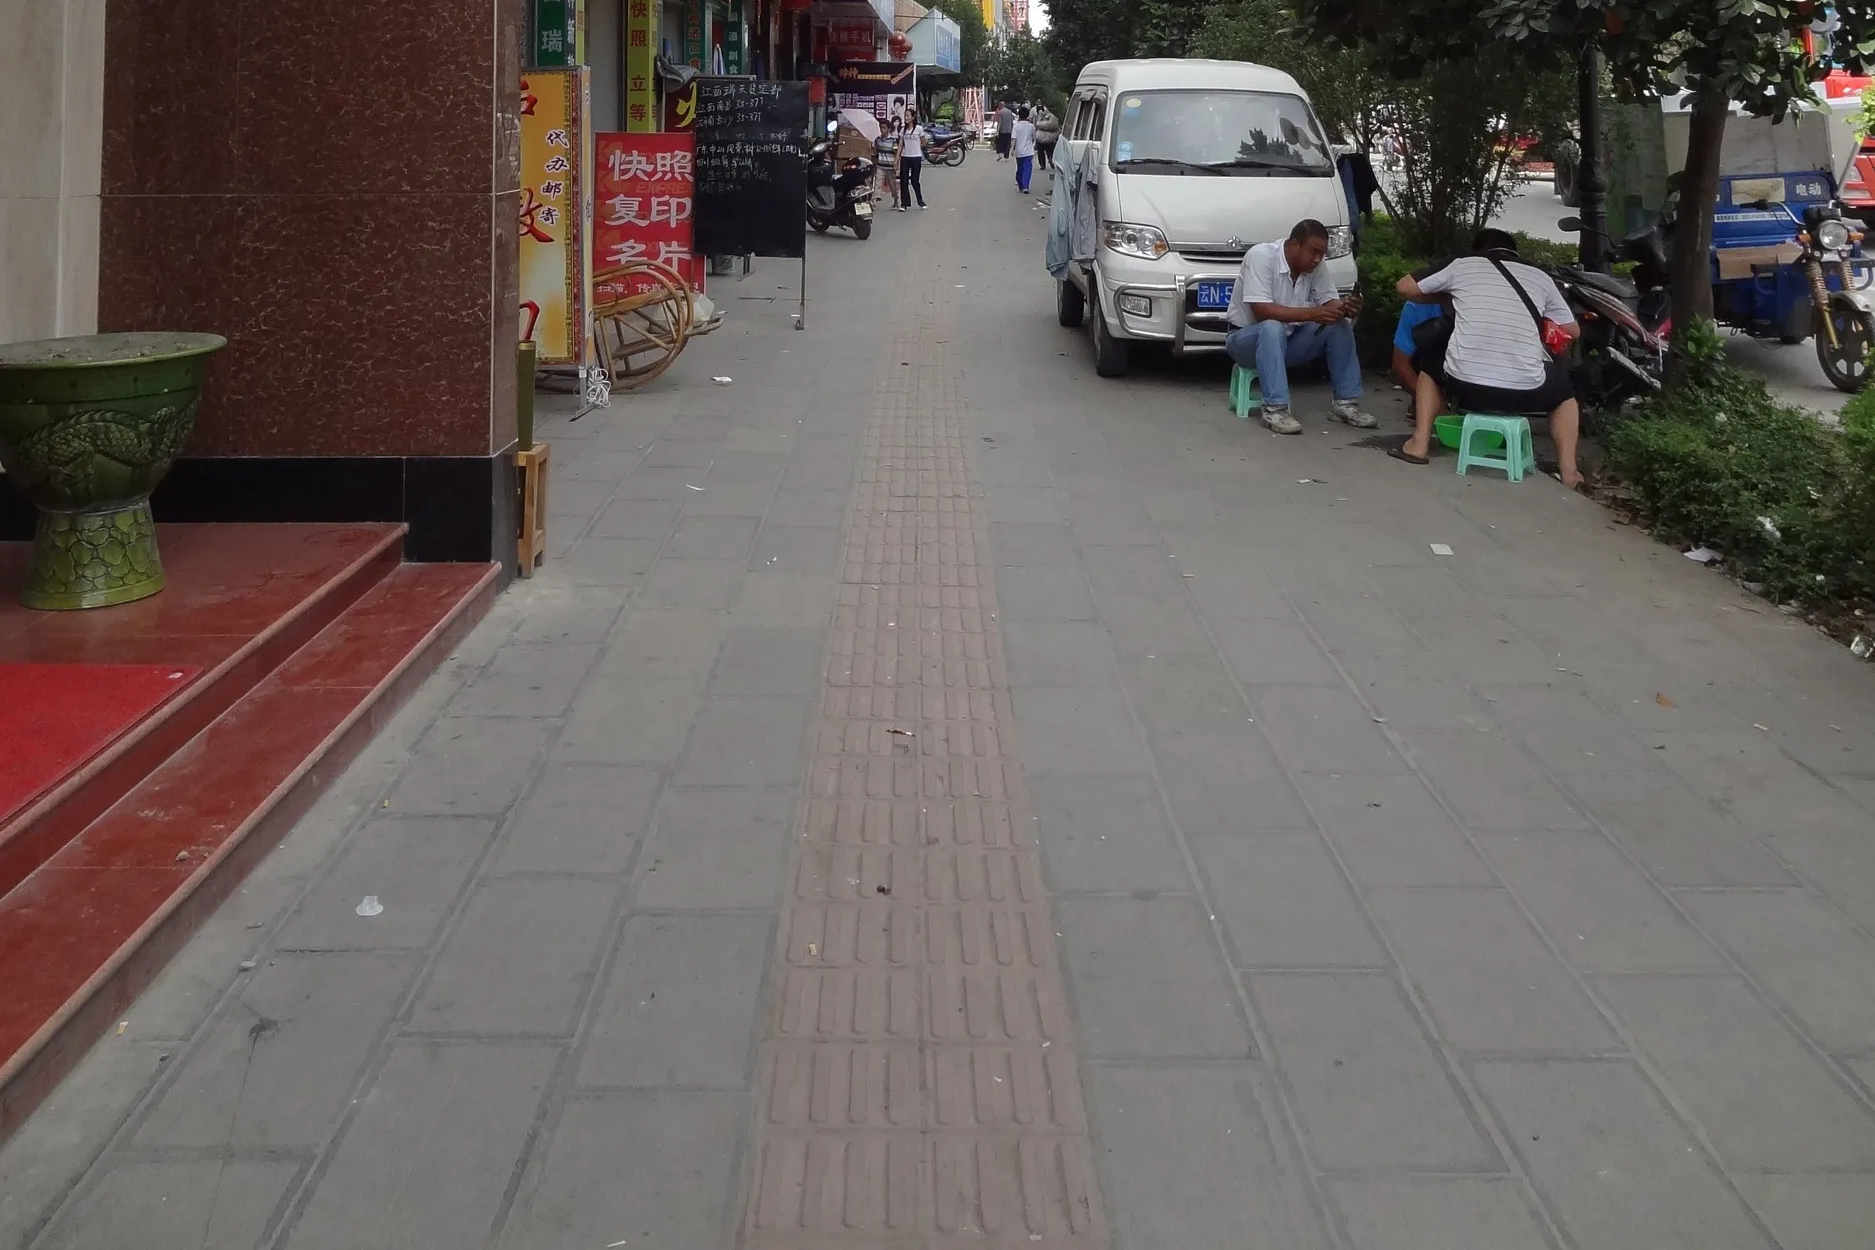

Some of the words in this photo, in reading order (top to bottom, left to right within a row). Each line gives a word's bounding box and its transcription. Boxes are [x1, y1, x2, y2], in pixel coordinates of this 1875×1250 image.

[539, 129, 570, 228] 代办邮寄
[608, 149, 695, 182] 快照
[1795, 183, 1821, 196] 电动
[604, 193, 692, 228] 复印
[605, 238, 692, 272] 名片
